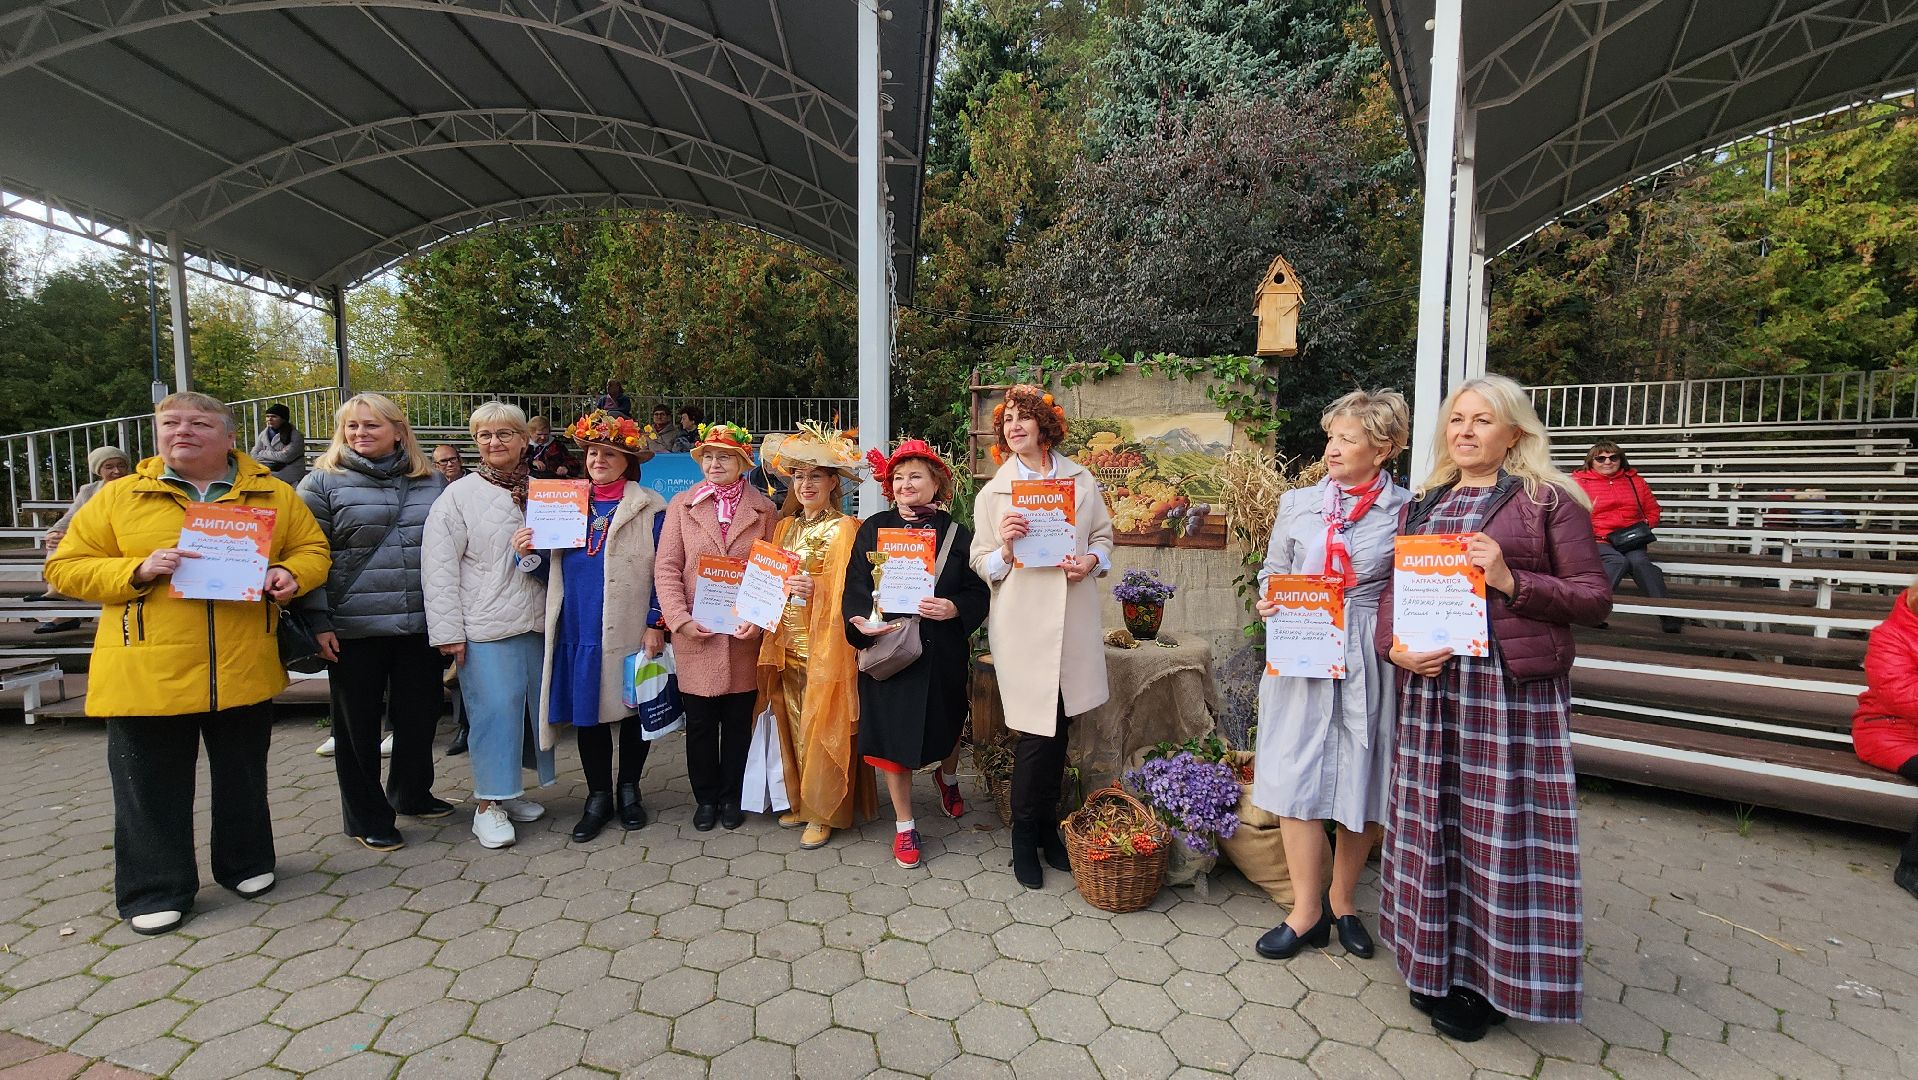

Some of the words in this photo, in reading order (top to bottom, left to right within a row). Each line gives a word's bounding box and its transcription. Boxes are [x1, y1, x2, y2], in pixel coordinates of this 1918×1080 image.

[534, 491, 578, 499] ДИПЛОМ
[1017, 494, 1064, 505] ДИПЛОМ
[192, 518, 258, 532] ДИПЛОМ
[882, 542, 925, 552] ДИПЛОМ
[754, 553, 788, 573] ДИПЛОМ
[1402, 554, 1467, 567] ДИПЛОМ
[1273, 591, 1330, 602] ДИПЛОМ
